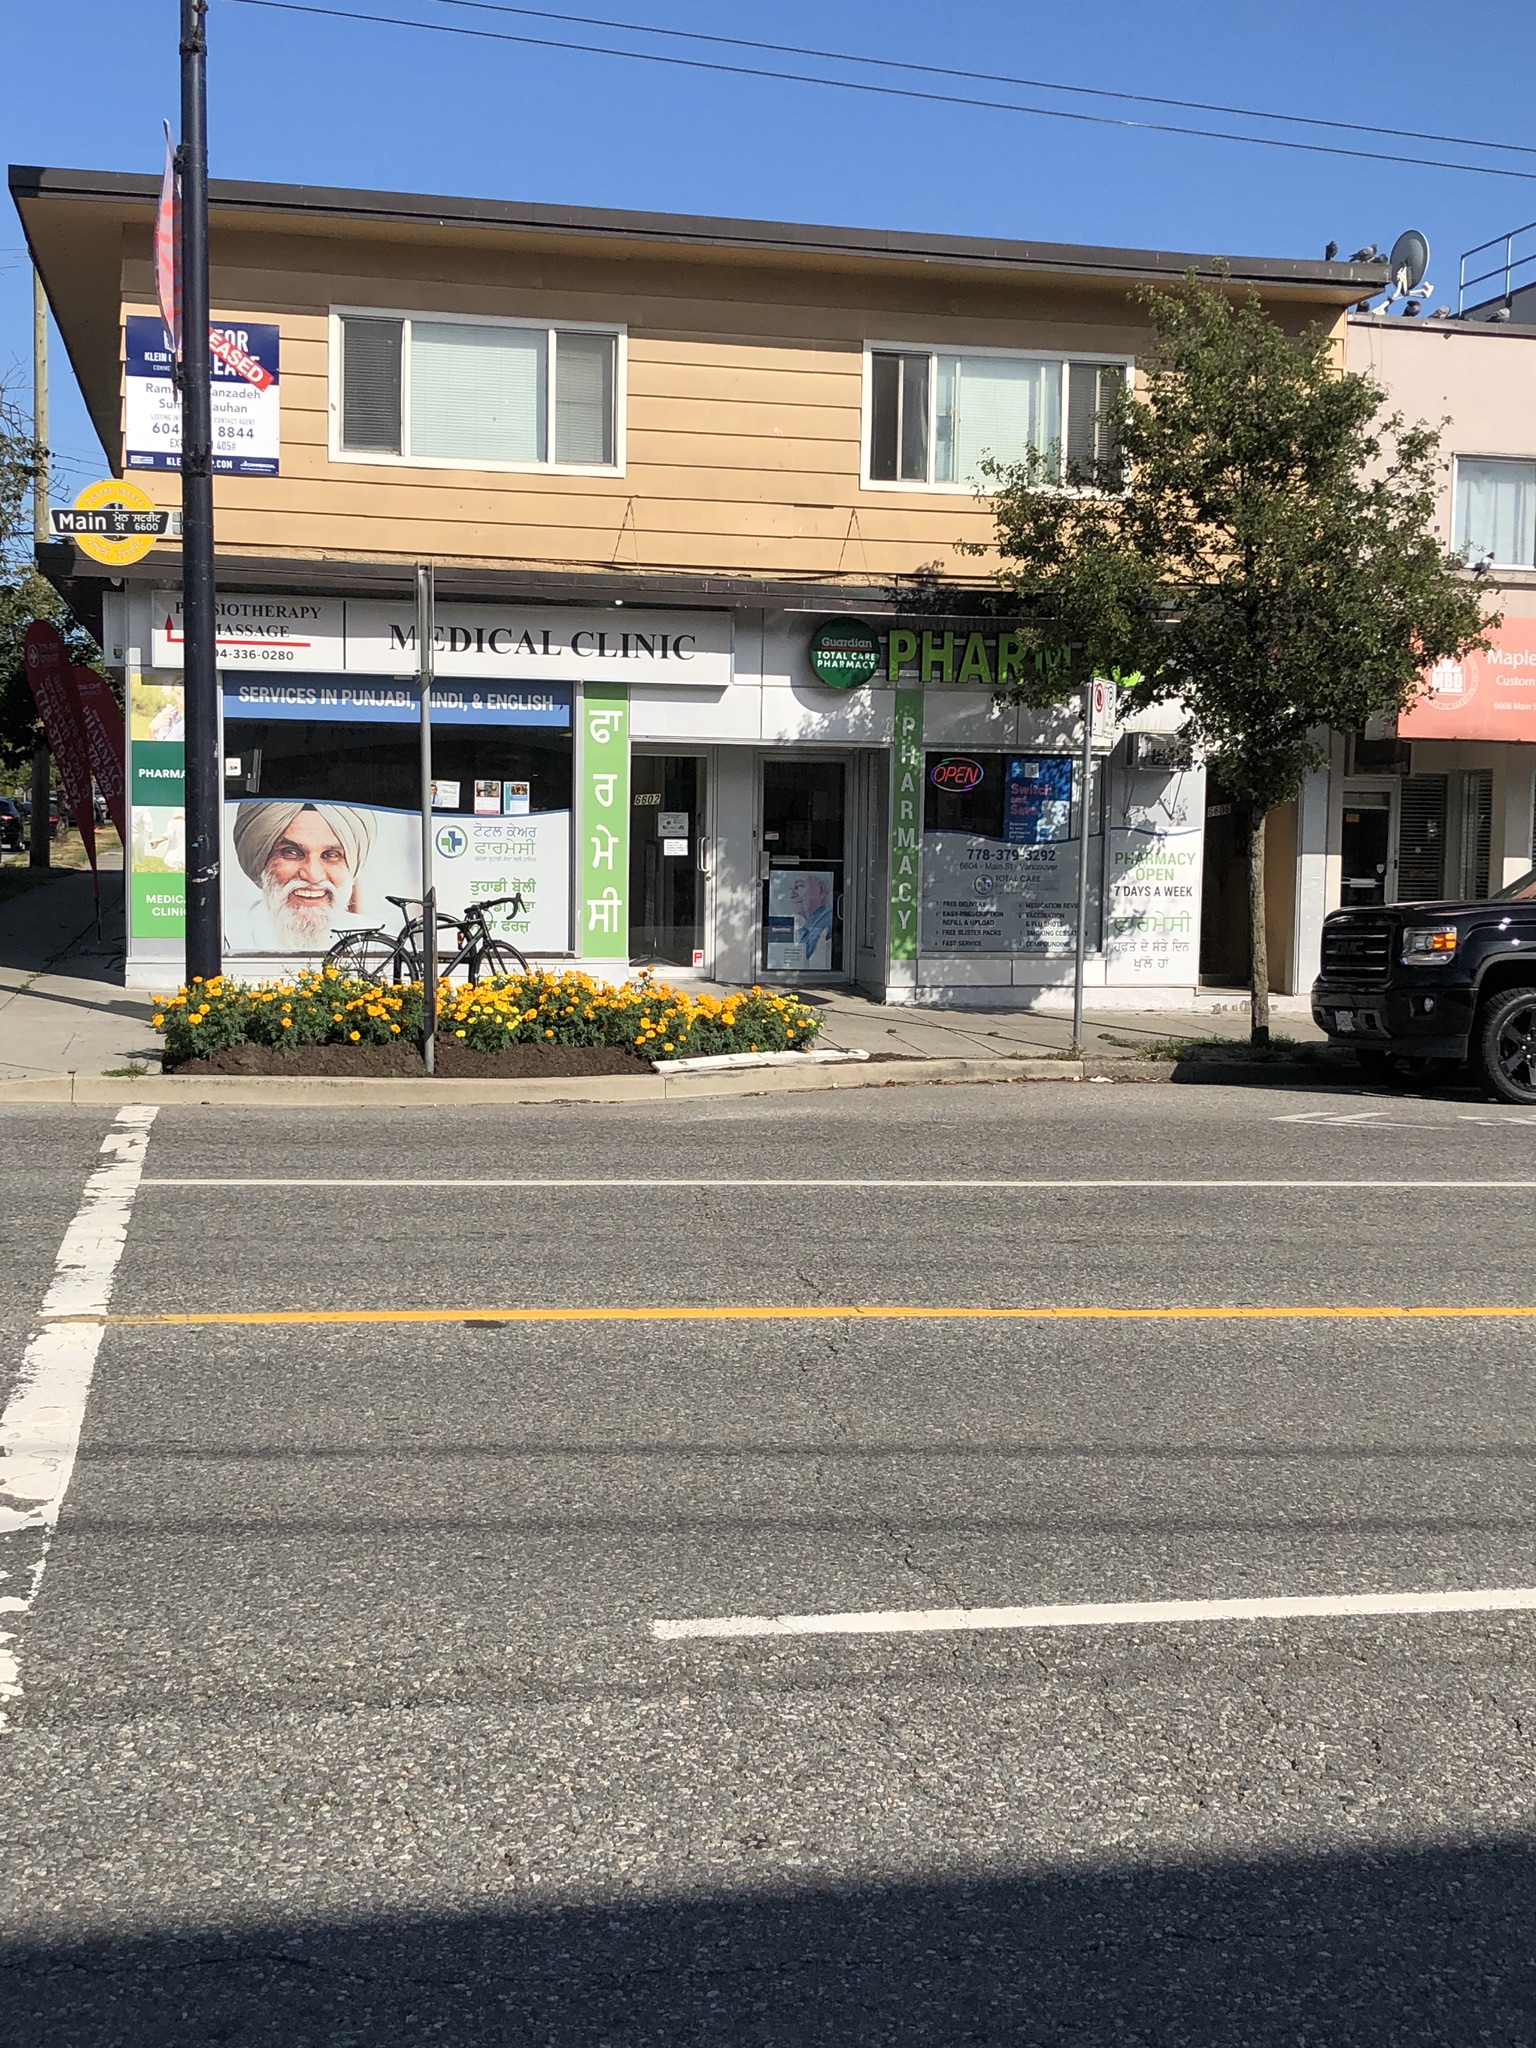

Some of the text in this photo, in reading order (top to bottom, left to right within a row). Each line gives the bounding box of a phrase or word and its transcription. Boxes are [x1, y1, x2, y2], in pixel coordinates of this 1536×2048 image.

[144, 351, 167, 363] KLEIN
[209, 331, 264, 383] EASED
[212, 402, 248, 414] auhan
[152, 423, 255, 439] 604 8844
[59, 512, 107, 531] Main
[115, 522, 159, 531] St 6600
[174, 601, 322, 620] PSIOTHERAPY
[389, 624, 697, 661] MEDICAL CLINIC
[821, 637, 873, 648] Guardian
[817, 651, 876, 661] TOTAL CARE
[1487, 648, 1536, 669] Maple
[817, 660, 875, 669] PHARMACY
[1431, 672, 1463, 689] MBD
[238, 685, 554, 712] SERVICES IN PUNJABI, INDI, & ENGLISH
[1493, 702, 1512, 710] 6608
[1513, 702, 1531, 711] Main
[36, 682, 81, 808] 778-379-3292
[82, 705, 124, 796] PHARMACY
[88, 744, 115, 800] 379-3292
[933, 766, 979, 784] OPEN
[1010, 783, 1052, 796] Switch
[635, 794, 661, 805] 6602
[1010, 804, 1038, 816] Save
[897, 716, 916, 930] PHARMACY
[473, 822, 502, 838] ਟੋਟਲ
[966, 849, 1056, 862] 778-379-3292
[1114, 852, 1196, 865] PHARMACY
[985, 862, 1002, 870] Main
[1019, 863, 1058, 871] Vancouver
[995, 875, 1041, 883] TOTAL CARE
[1135, 868, 1175, 881] OPEN
[470, 877, 508, 896] ਤੁਹਾਡੀ
[1114, 886, 1193, 897] 7 DAYS A WEEK
[145, 894, 186, 904] MEDIC
